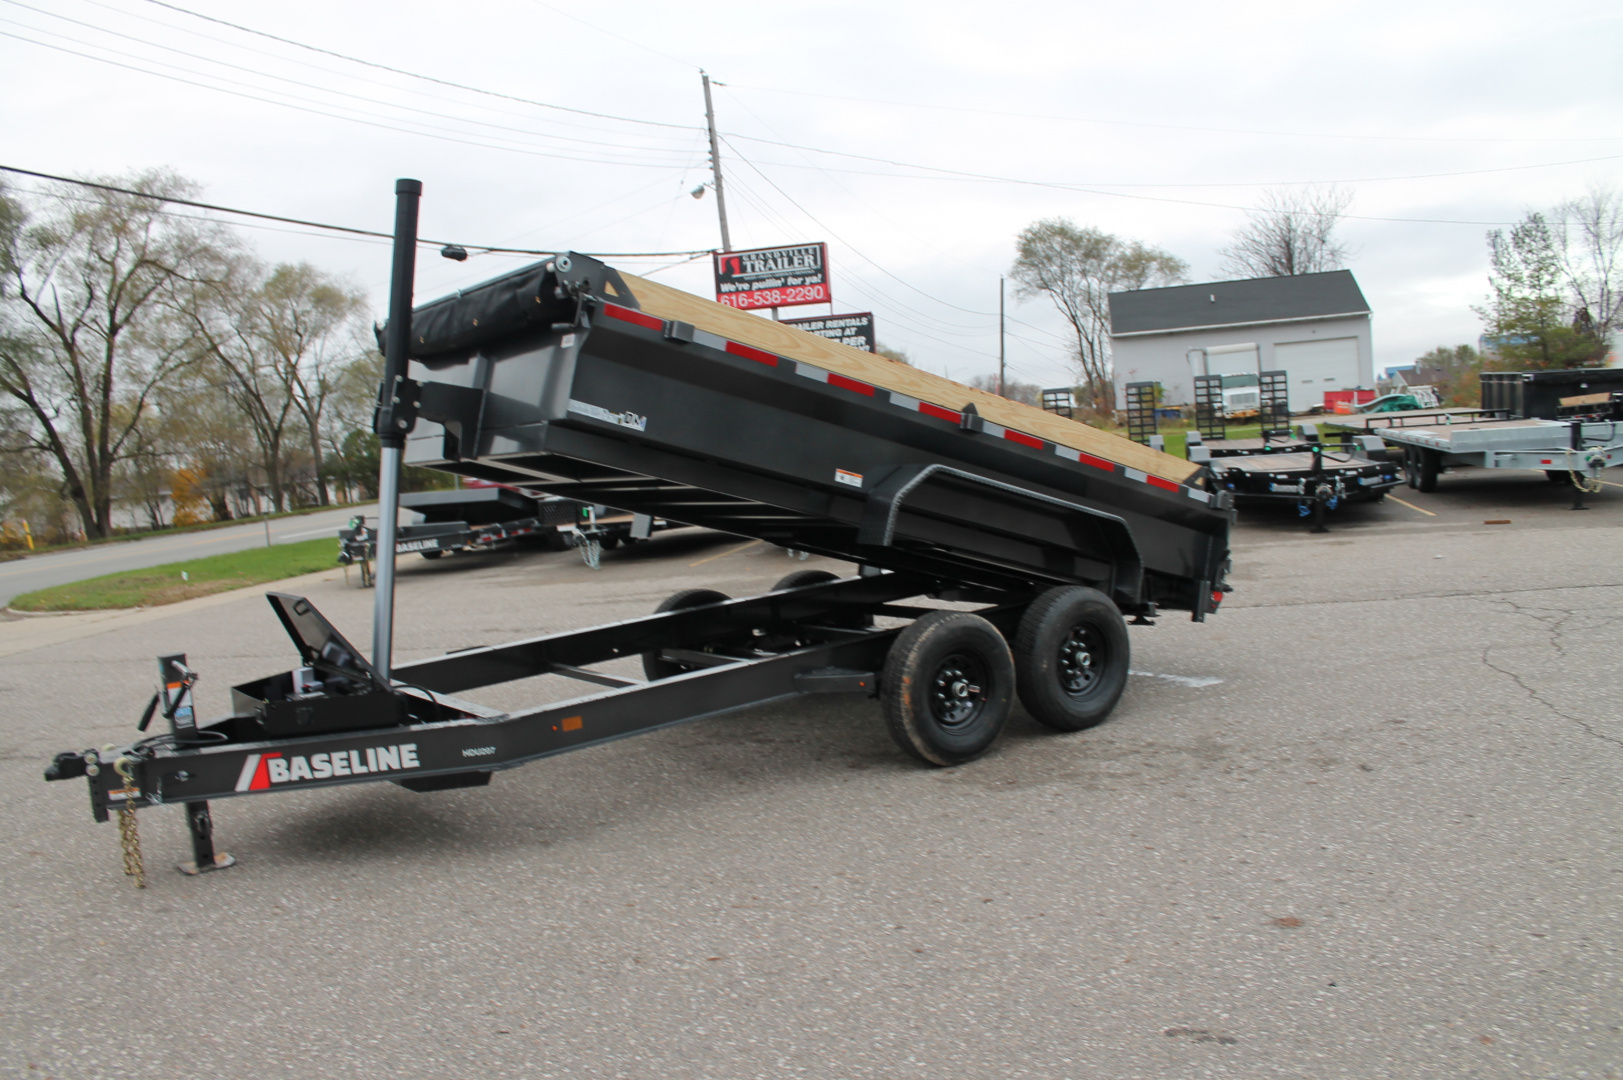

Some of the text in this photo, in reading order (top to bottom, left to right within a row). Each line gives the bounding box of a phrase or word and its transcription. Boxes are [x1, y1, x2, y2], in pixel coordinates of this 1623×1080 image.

[742, 247, 815, 261] GRANDVILLE
[743, 254, 816, 273] TRAILER
[720, 281, 750, 293] We're
[787, 276, 804, 286] for
[805, 273, 822, 286] ya!
[720, 285, 824, 307] 616-538-2290
[825, 316, 869, 329] RENTALS
[843, 327, 858, 336] AT
[267, 743, 421, 783] BASELINE
